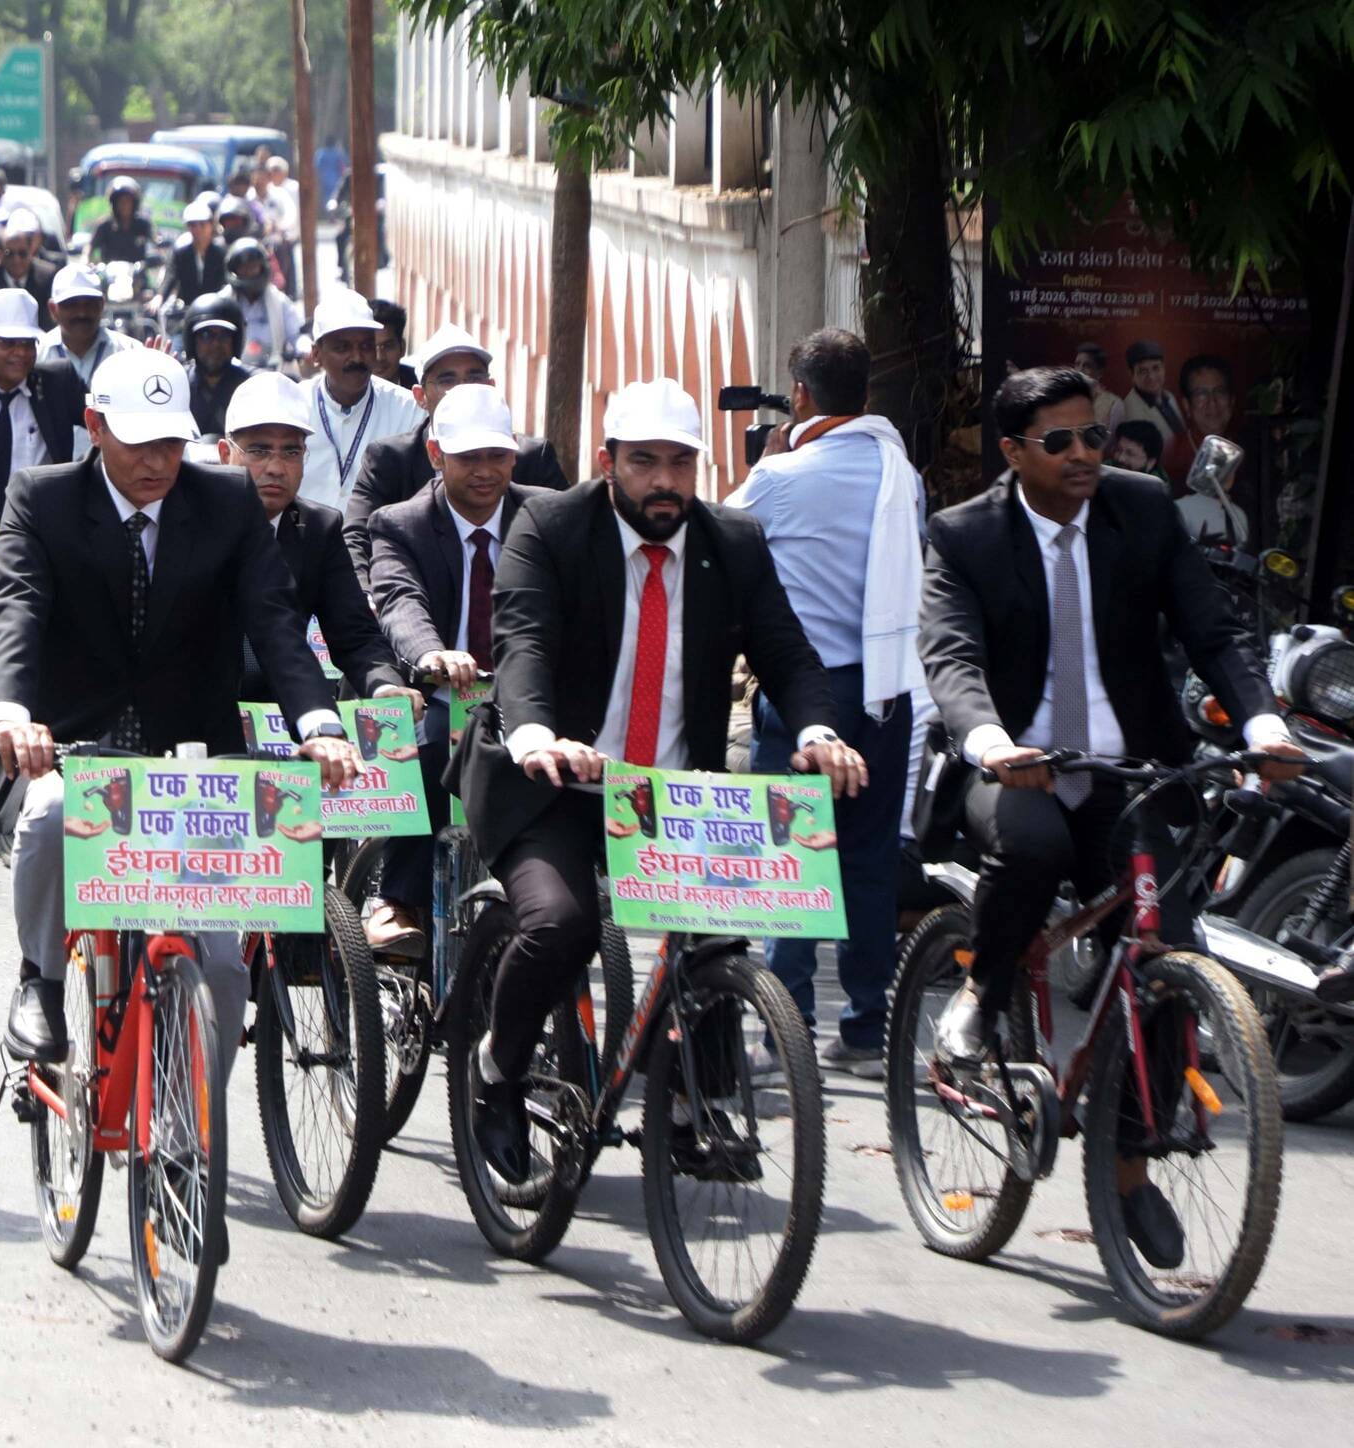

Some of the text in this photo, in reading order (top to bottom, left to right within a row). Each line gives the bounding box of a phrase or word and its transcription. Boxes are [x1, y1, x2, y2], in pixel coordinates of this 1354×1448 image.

[148, 774, 239, 803] एक राष्ट्र
[286, 774, 311, 787] FUEL
[667, 783, 703, 806] एक
[711, 786, 751, 815] राष्ट्र
[138, 803, 250, 836] एक संकल्प
[661, 812, 766, 845] एक संकल्प
[187, 845, 282, 876] बचाओ
[710, 853, 801, 881] बचाओ
[77, 878, 119, 905] हरित
[124, 879, 150, 903] एवं
[255, 881, 312, 905] बनाओ
[615, 877, 653, 901] हरित
[657, 880, 680, 903] एवं
[777, 888, 832, 910] बनाओ
